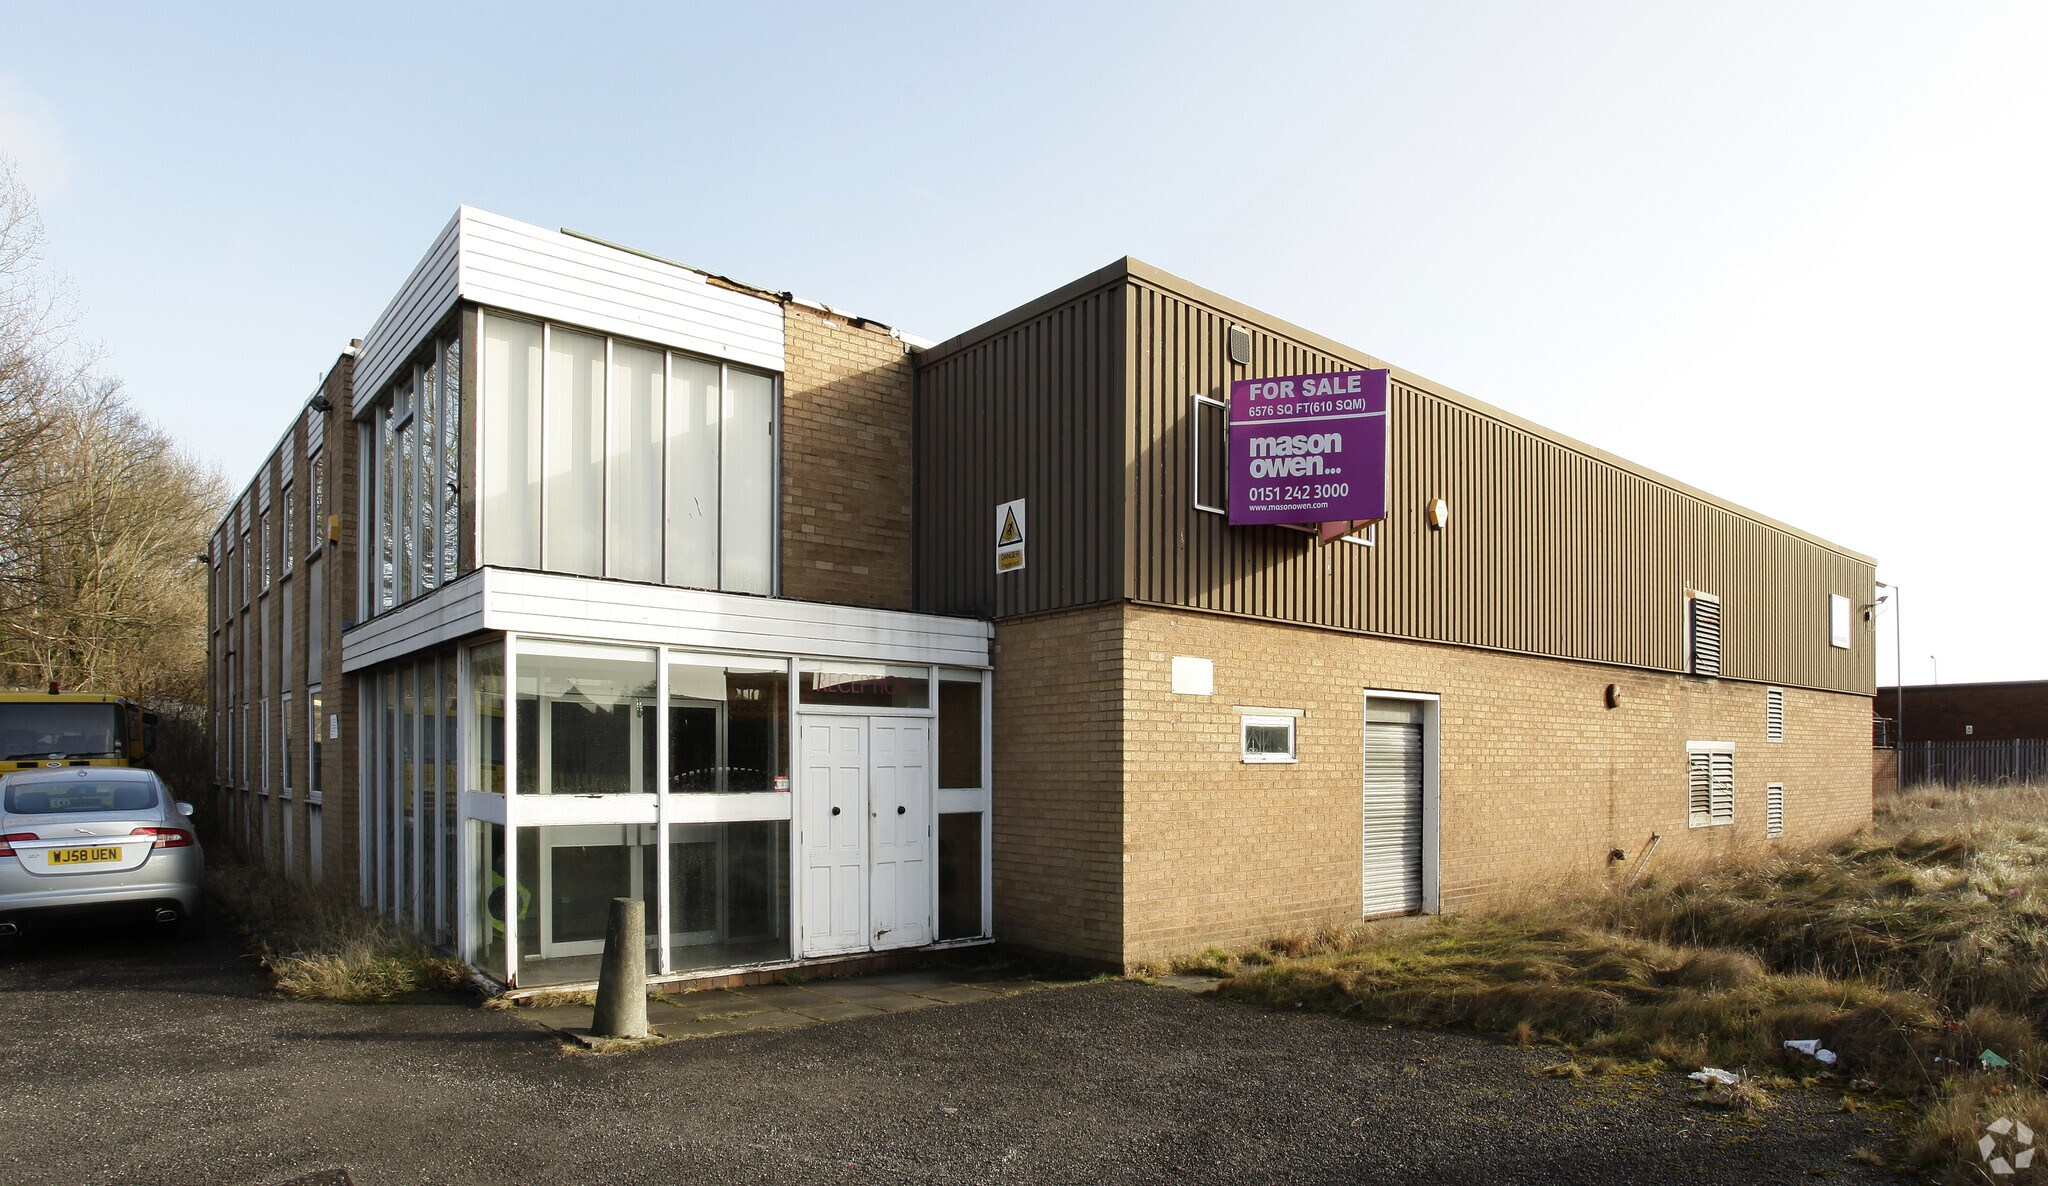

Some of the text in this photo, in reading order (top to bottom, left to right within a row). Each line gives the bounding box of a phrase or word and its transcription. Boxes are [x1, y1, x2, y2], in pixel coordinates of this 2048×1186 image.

[1249, 375, 1362, 400] FOR SALE
[1249, 405, 1274, 417] 6576
[1276, 404, 1293, 416] SQ
[1335, 398, 1366, 412] SQM)
[1249, 432, 1342, 457] mason
[1249, 482, 1349, 501] 0151 242 3000
[1249, 501, 1329, 511] www.masonowen.com
[1001, 551, 1020, 560] DANGER
[817, 672, 912, 695] RECEPTION
[91, 848, 117, 860] UEN
